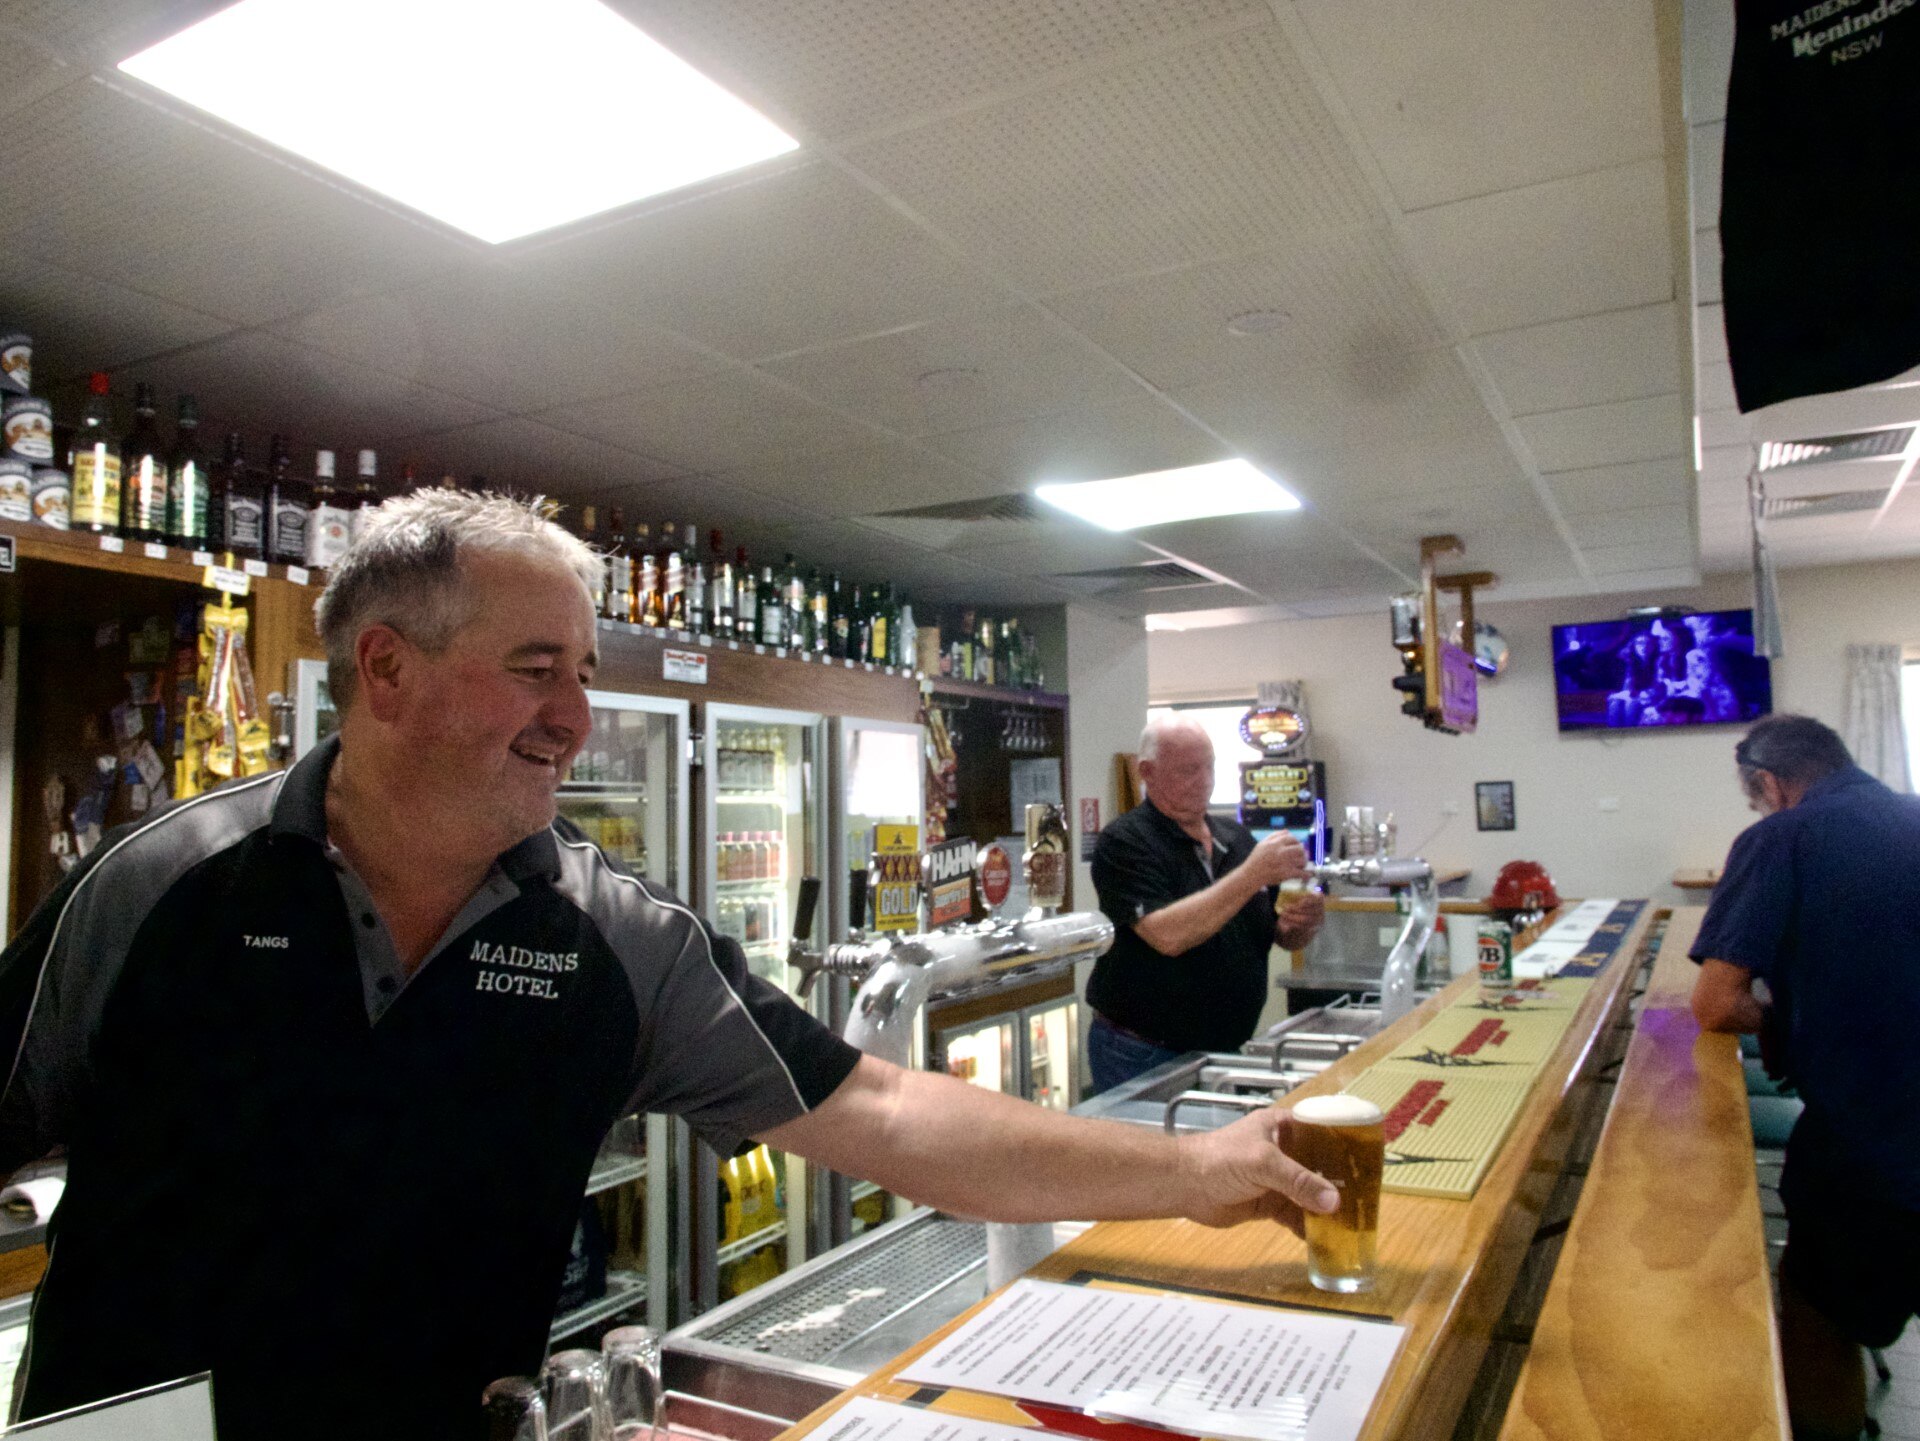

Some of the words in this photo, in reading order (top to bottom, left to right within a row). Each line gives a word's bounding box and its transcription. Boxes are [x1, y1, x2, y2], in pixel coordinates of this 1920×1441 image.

[1831, 31, 1884, 66] NSW
[880, 854, 922, 882] XXXX
[932, 841, 977, 882] HAHN
[881, 886, 918, 915] GOLD
[243, 934, 289, 949] TANGS
[470, 939, 579, 972] MAIDENS
[475, 970, 559, 999] HOTEL
